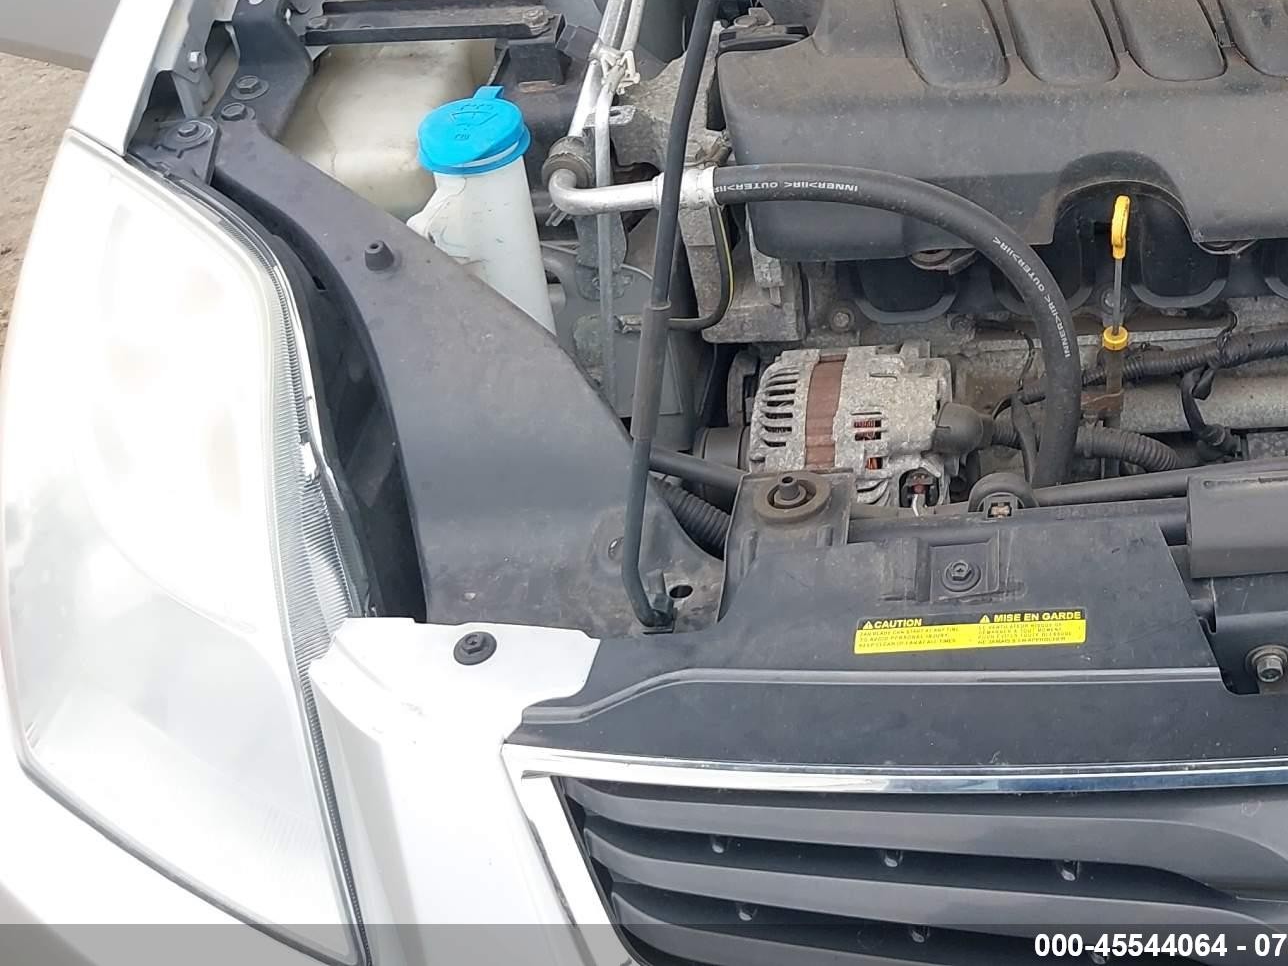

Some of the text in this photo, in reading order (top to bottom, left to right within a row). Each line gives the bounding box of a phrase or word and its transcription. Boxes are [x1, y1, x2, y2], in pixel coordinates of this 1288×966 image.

[994, 611, 1082, 623] MISE EN GARDE
[874, 618, 923, 629] CAUTION
